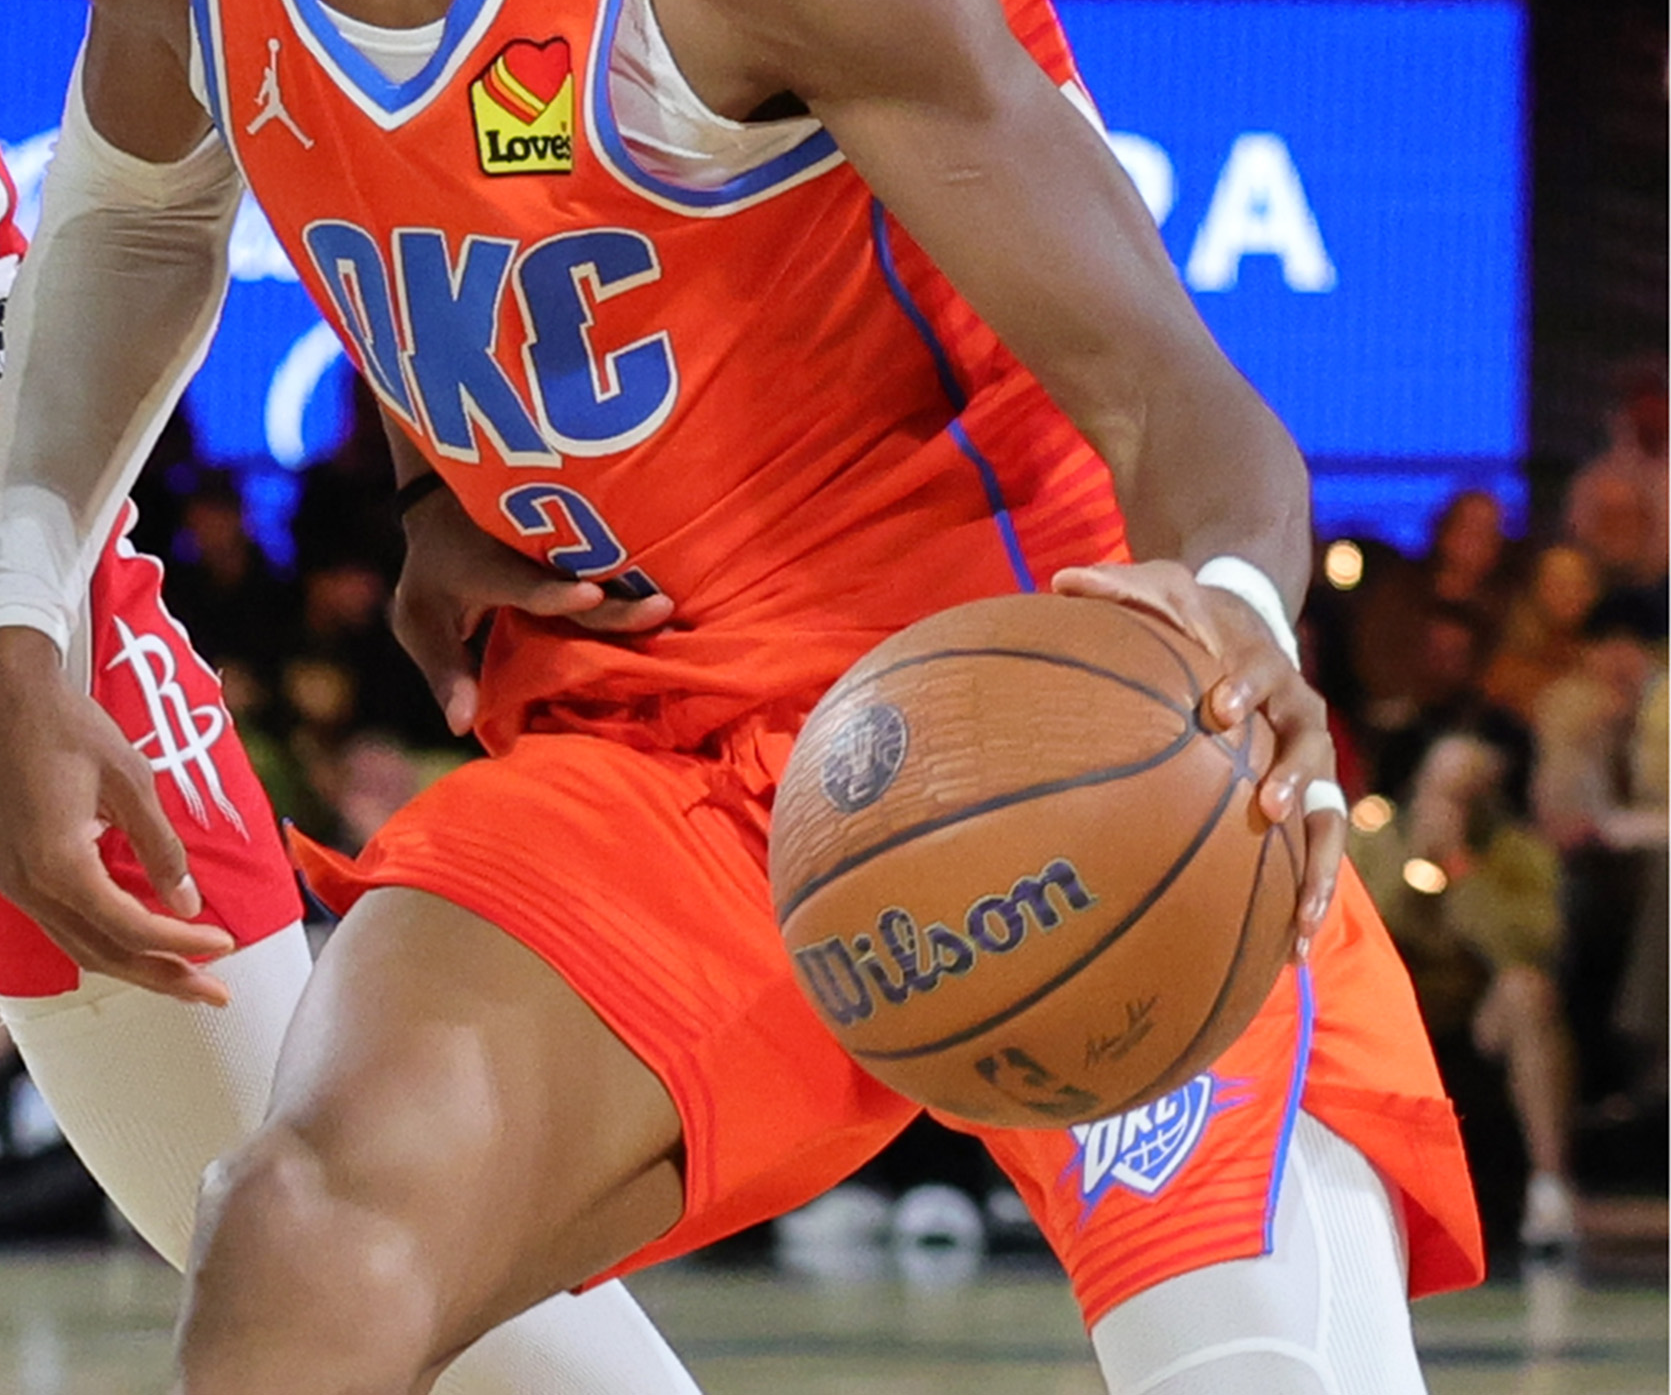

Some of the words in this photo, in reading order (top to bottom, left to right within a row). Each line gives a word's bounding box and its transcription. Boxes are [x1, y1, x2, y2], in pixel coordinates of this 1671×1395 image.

[302, 218, 680, 468] OKC
[499, 482, 663, 598] 2
[792, 857, 1099, 1027] Wilson
